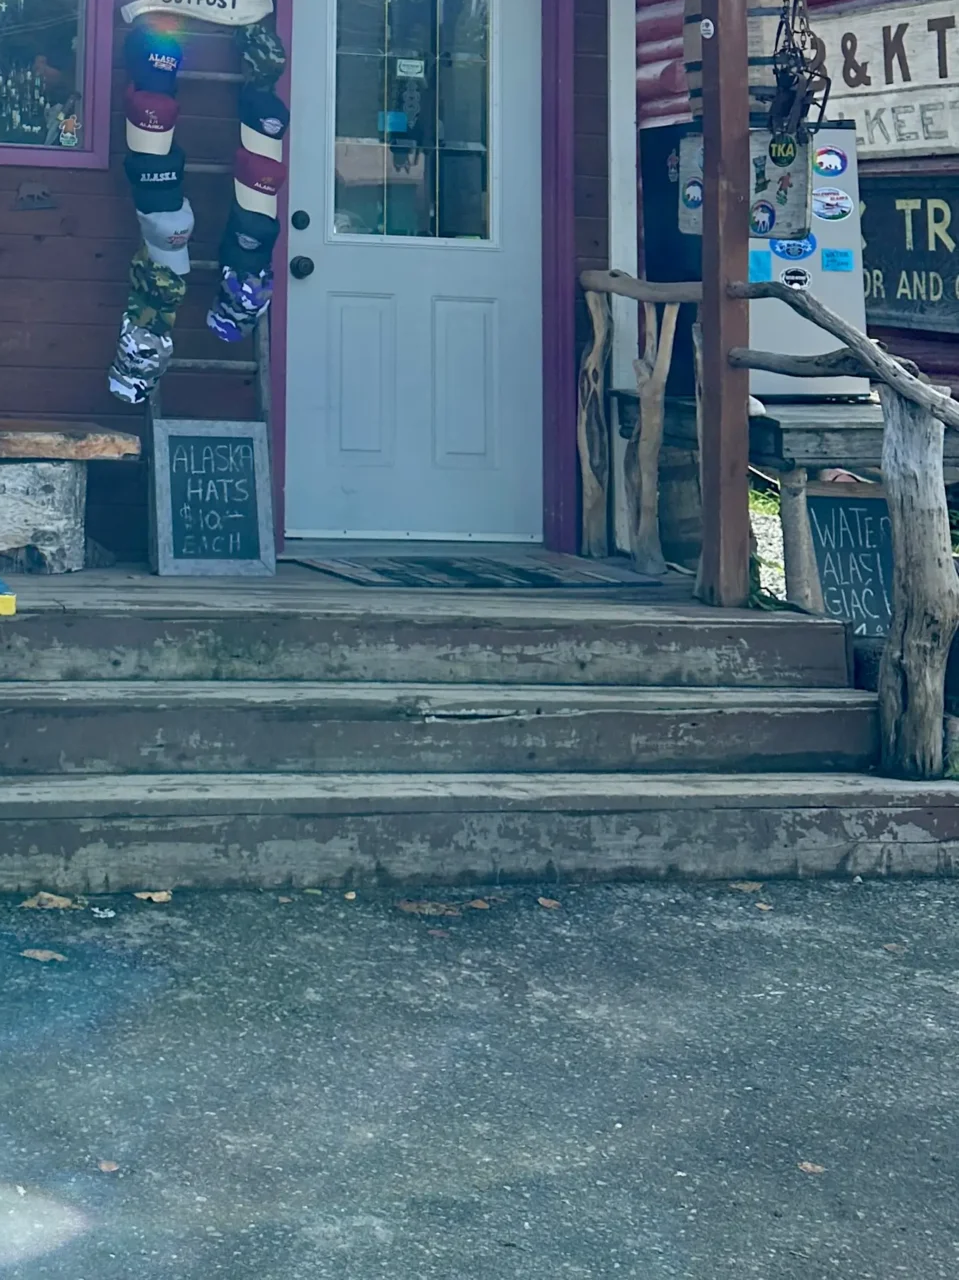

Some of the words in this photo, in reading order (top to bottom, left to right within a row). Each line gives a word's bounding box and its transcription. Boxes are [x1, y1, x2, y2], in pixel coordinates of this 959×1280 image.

[841, 31, 872, 89] &
[882, 23, 912, 85] K
[770, 143, 795, 158] TKA
[140, 171, 178, 182] ALASKA
[896, 270, 944, 302] AND
[172, 443, 254, 474] ALASKA
[187, 478, 249, 503] HATS
[183, 533, 241, 554] EACH
